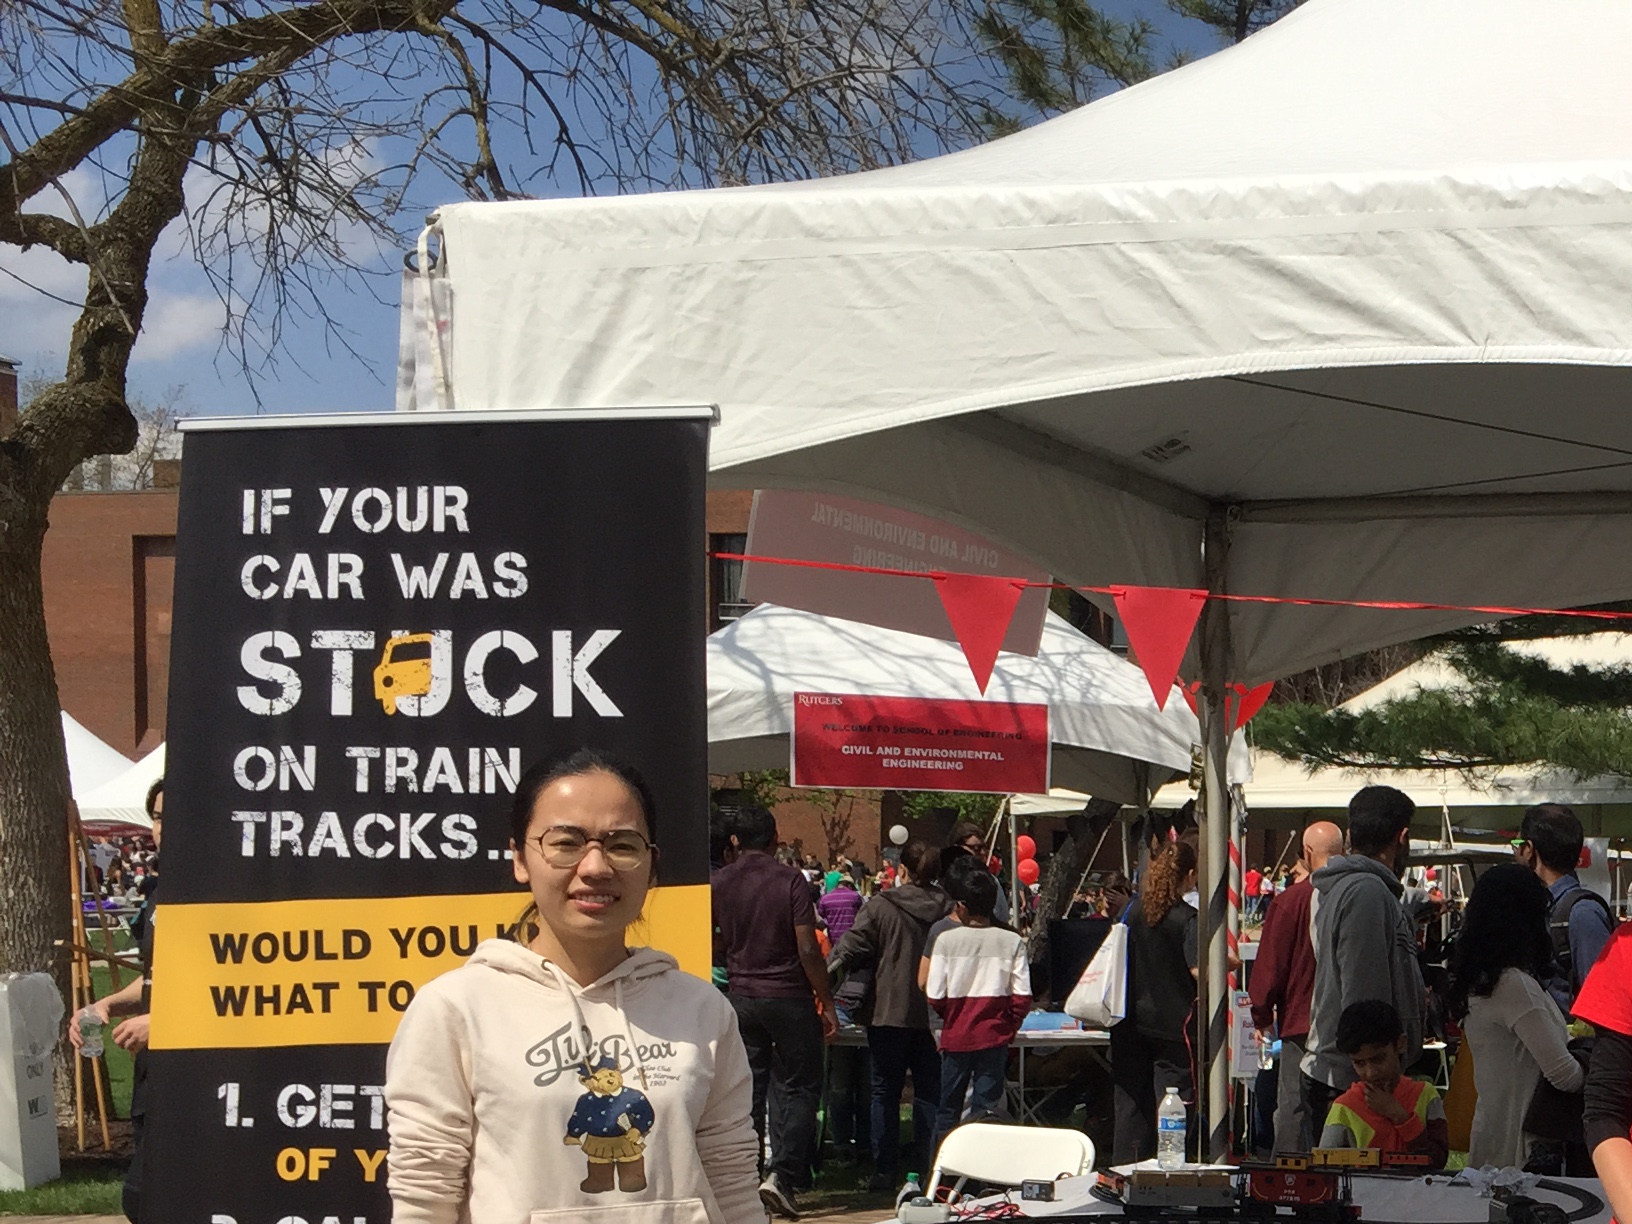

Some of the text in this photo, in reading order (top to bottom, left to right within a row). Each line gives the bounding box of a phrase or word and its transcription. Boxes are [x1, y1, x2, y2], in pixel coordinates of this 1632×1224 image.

[241, 485, 470, 535] IF YOUR
[240, 551, 528, 600] CAR WAS
[236, 628, 624, 717] STUCK
[823, 723, 872, 733] WELCOME
[875, 725, 890, 733] TO
[893, 726, 934, 737] SCHOOL
[937, 728, 950, 736] OF
[232, 746, 521, 794] ON TRAIN
[841, 745, 1005, 761] CIVIL AND ENVIRONMENTAL
[882, 758, 964, 770] ENGINEERING
[209, 929, 372, 964] WOULD
[389, 925, 479, 958] YOU
[209, 981, 413, 1017] WHAT TO
[599, 1034, 677, 1074] Bear
[217, 1083, 387, 1130] 1. GET
[276, 1149, 336, 1182] OF
